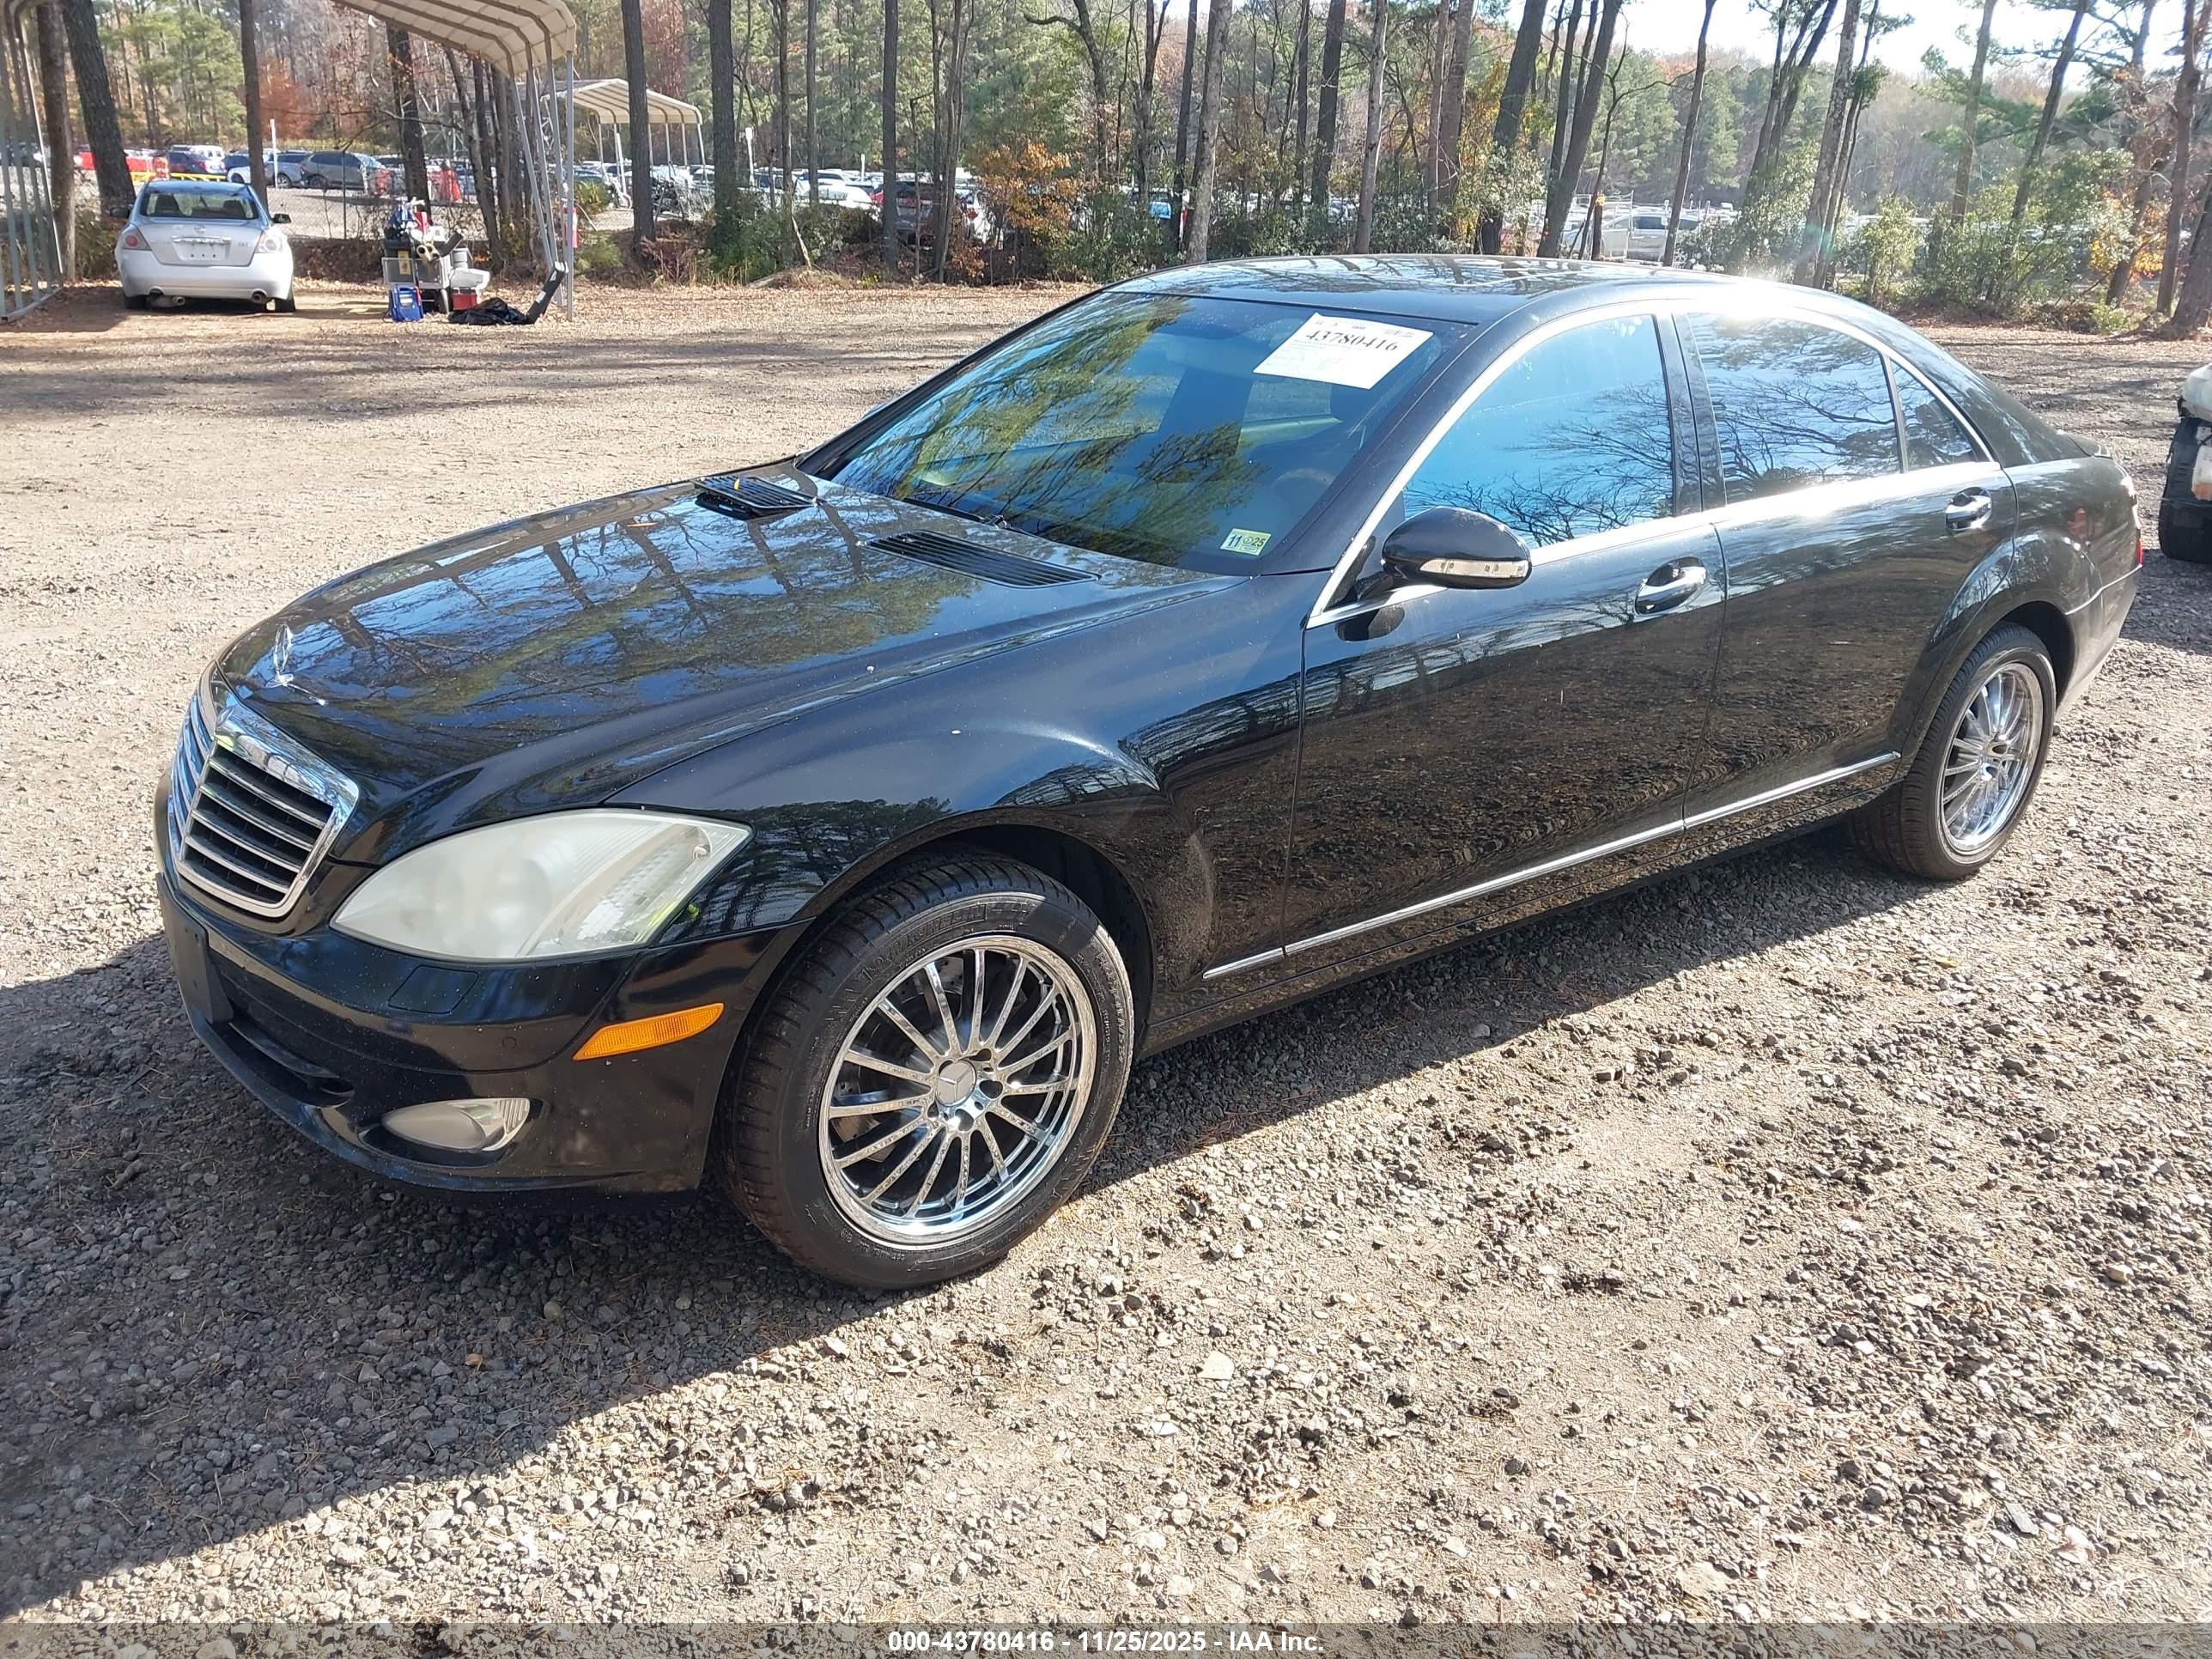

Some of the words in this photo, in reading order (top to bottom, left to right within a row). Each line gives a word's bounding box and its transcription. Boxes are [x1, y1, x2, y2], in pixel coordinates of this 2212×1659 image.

[1306, 330, 1398, 350] 43780416
[1228, 534, 1243, 547] 11
[1250, 537, 1266, 547] 25
